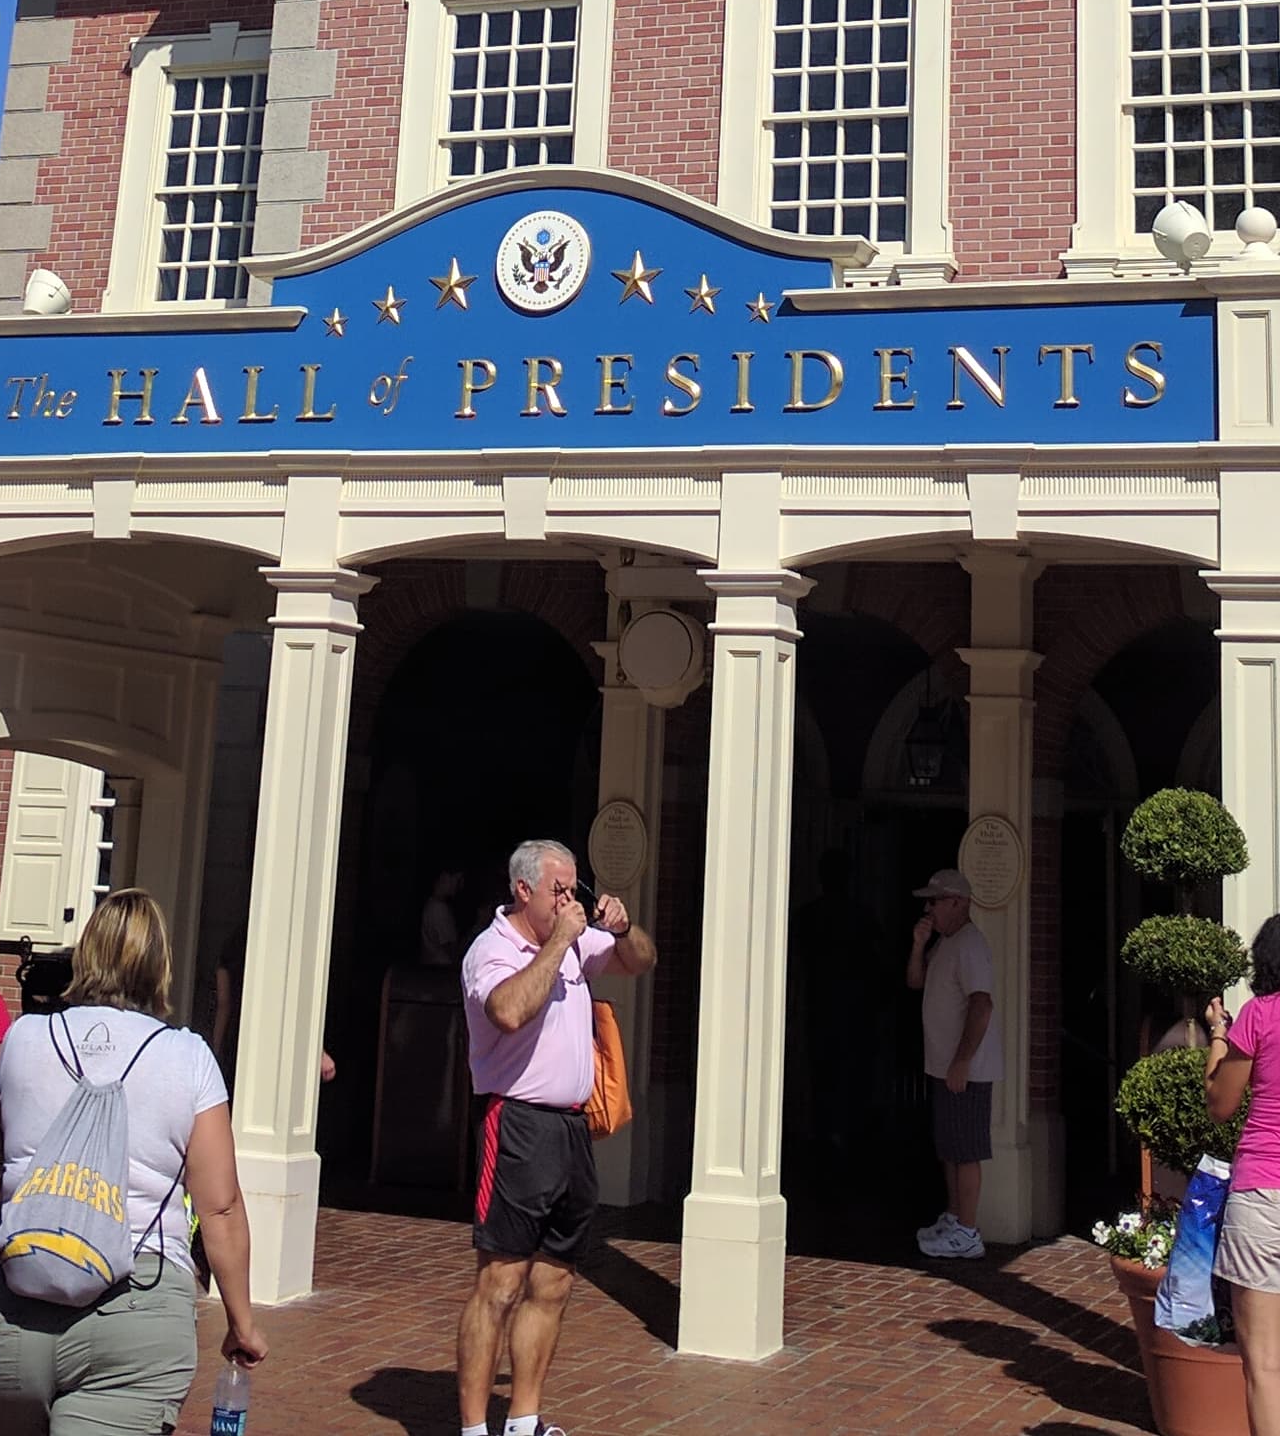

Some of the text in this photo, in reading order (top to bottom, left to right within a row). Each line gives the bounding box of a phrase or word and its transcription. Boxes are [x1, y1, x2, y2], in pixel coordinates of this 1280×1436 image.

[7, 340, 1166, 425] The HALL of PRESIDENTS
